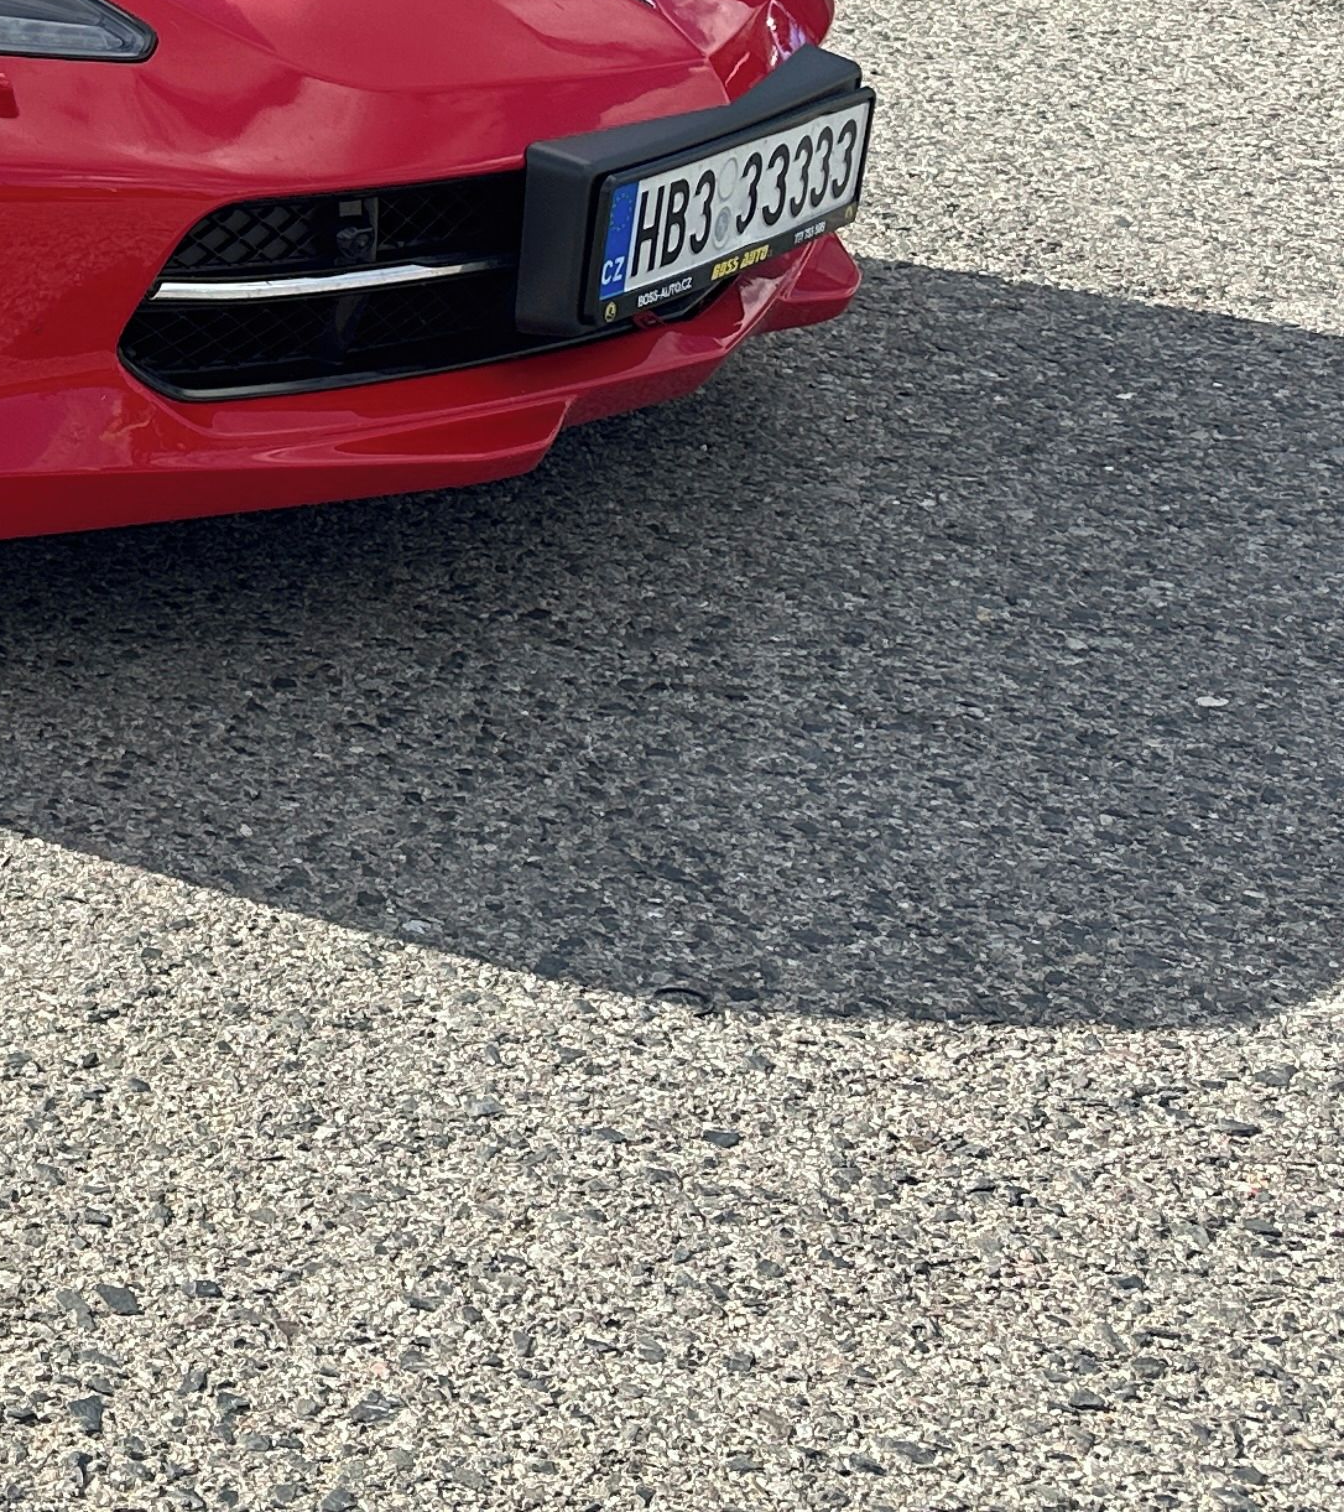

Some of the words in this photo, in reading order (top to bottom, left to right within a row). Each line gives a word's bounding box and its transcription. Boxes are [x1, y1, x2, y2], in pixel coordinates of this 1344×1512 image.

[630, 169, 716, 277] HB3
[735, 118, 858, 235] 33333
[600, 255, 625, 286] CZ
[711, 255, 740, 281] BOSS
[740, 244, 770, 271] AUTO
